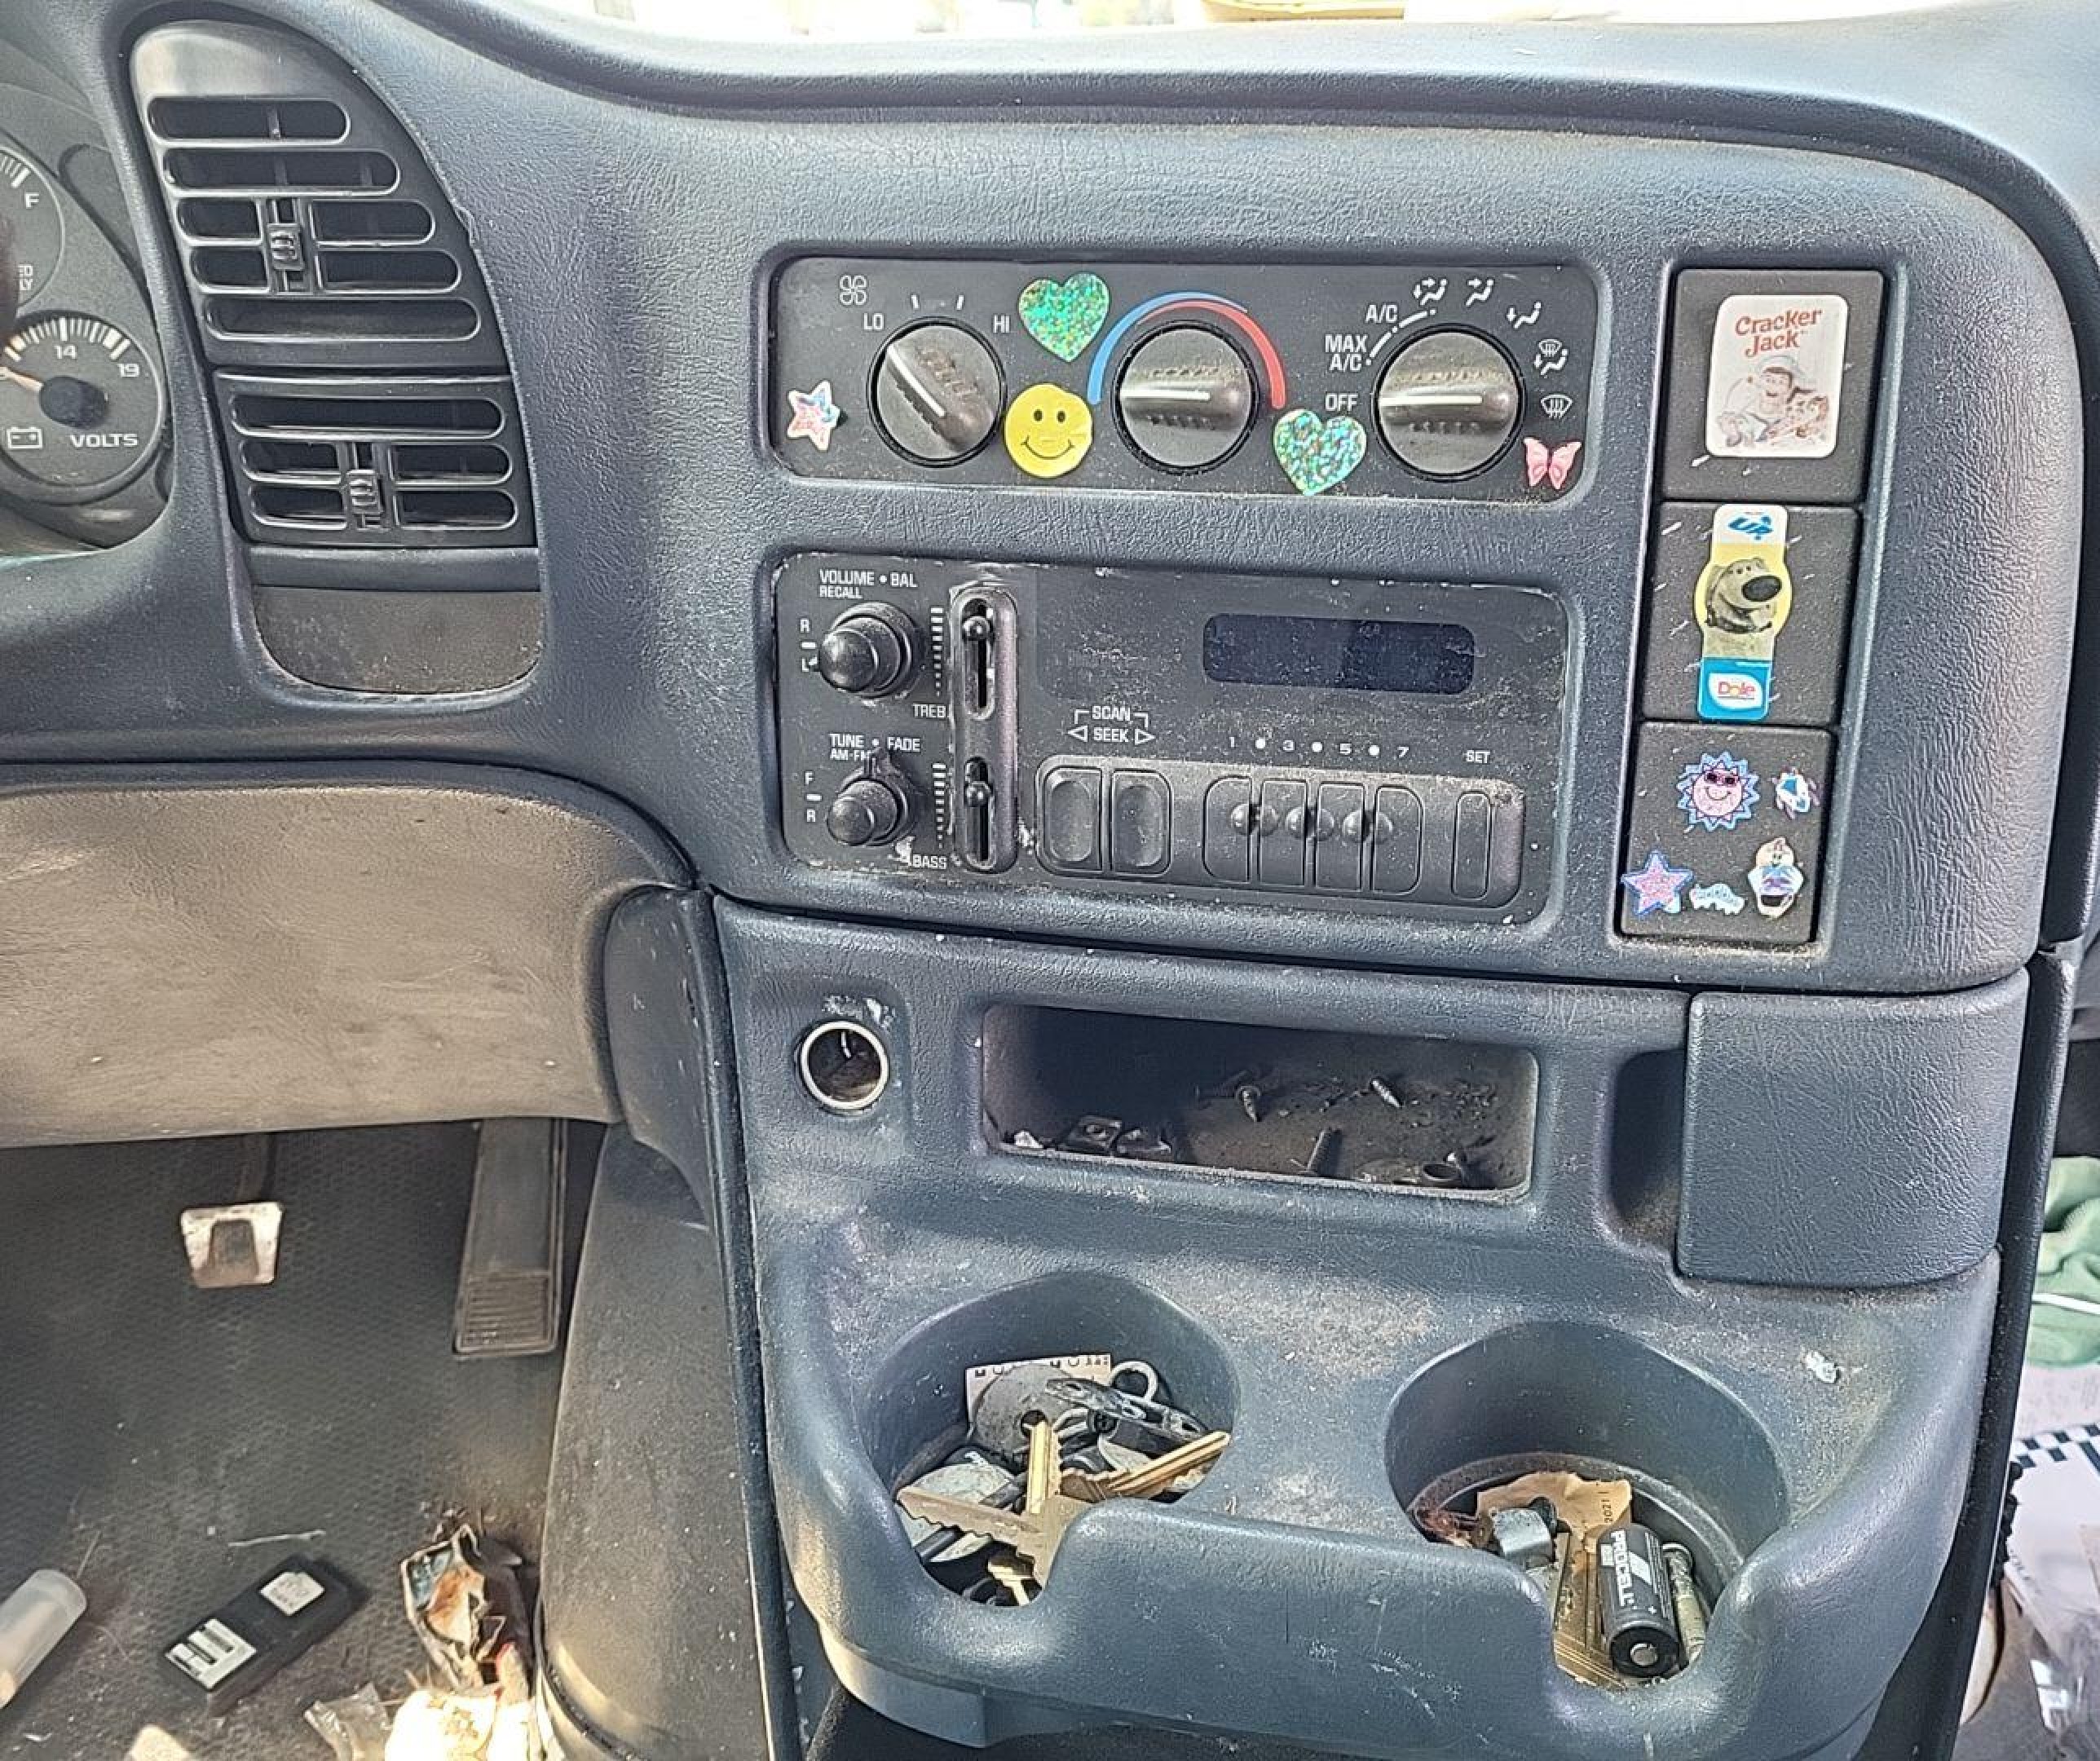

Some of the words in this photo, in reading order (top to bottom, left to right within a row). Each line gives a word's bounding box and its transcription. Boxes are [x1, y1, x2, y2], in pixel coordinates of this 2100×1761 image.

[25, 193, 39, 208] F
[863, 313, 885, 329] LO
[1365, 304, 1398, 323] A/C
[993, 315, 1010, 333] HI
[1735, 309, 1823, 336] Cracker
[1325, 334, 1368, 352] MAX
[1745, 330, 1800, 357] Jack
[54, 346, 77, 359] 14
[117, 364, 139, 377] 19
[1328, 354, 1362, 372] A/C
[1325, 393, 1359, 411] OFF
[70, 433, 139, 448] VOLTS
[819, 569, 875, 585] VOLUME
[889, 572, 918, 587] BAL
[819, 585, 863, 598] RECALL
[800, 618, 810, 633] R
[802, 658, 810, 672] L
[1718, 681, 1756, 695] Dole
[1092, 705, 1131, 721] SCAN
[1093, 726, 1129, 742] SEEK
[830, 734, 865, 748] TUNE
[887, 736, 921, 752] FADE
[1229, 736, 1236, 748] 1
[1282, 739, 1295, 752] 3
[1339, 743, 1352, 755] 5
[1396, 746, 1410, 758] 7
[1467, 749, 1491, 764] SET
[805, 771, 814, 785] F
[806, 809, 816, 823] R
[912, 854, 947, 869] BASS
[1611, 1531, 1634, 1607] PROCELL
